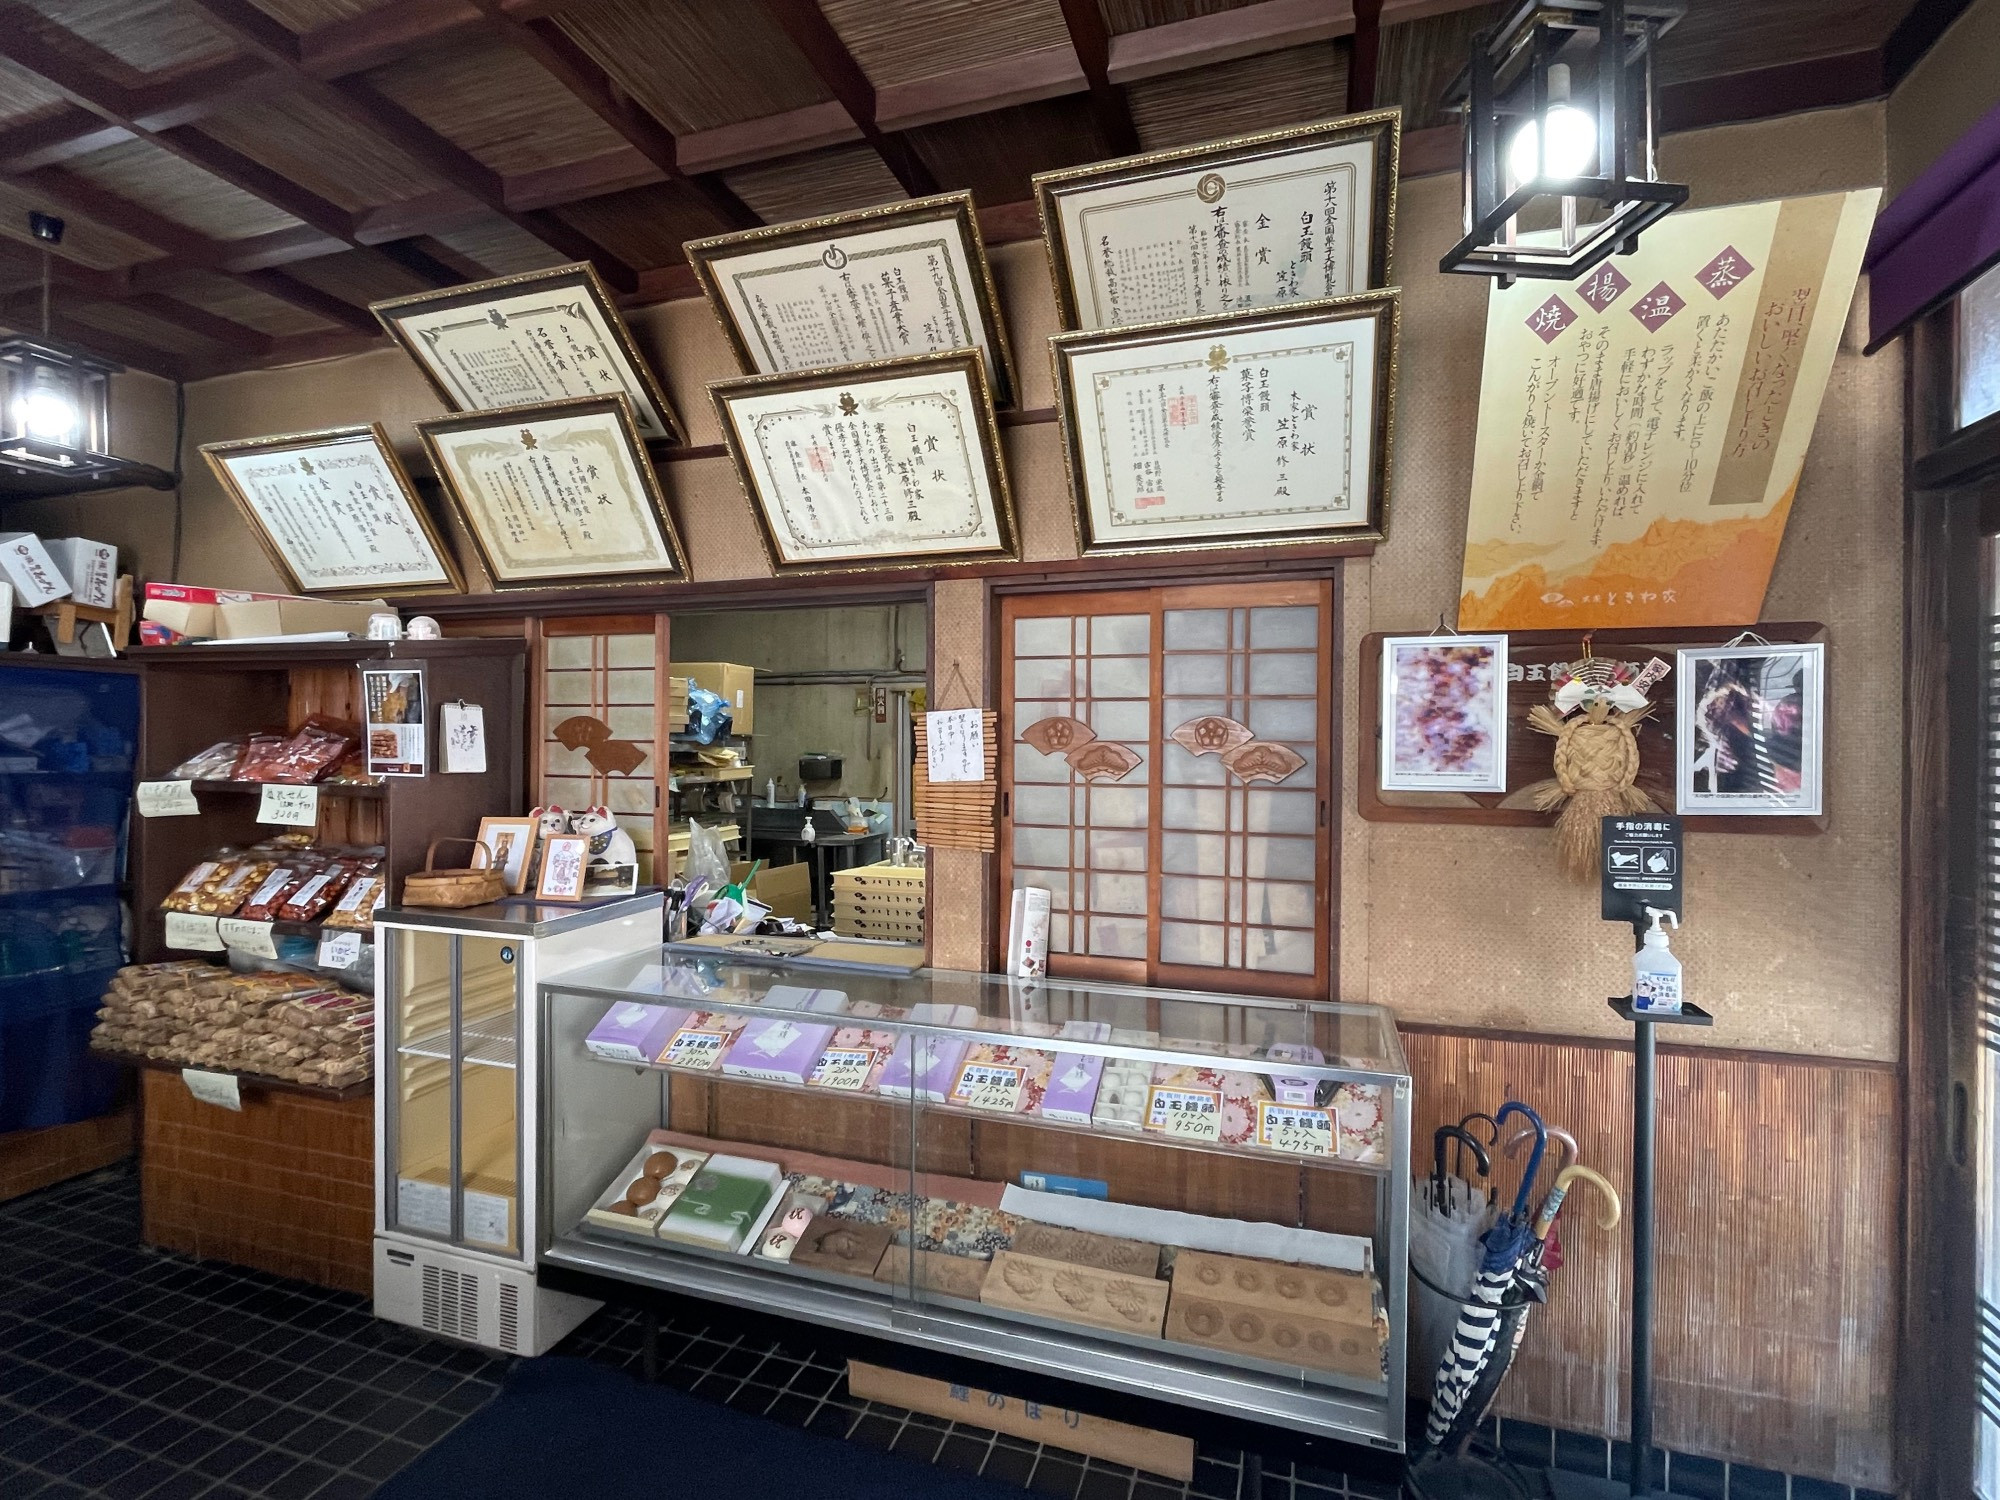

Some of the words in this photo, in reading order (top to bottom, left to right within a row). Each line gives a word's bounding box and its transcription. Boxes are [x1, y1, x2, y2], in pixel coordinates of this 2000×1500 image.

[1255, 213, 1271, 265] 金賞
[1299, 211, 1314, 263] 白玉饅頭
[893, 267, 910, 302] 白玉饅頭
[1586, 272, 1618, 303] 揚
[1710, 256, 1741, 289] 蒸
[1535, 304, 1568, 334] 焼
[1641, 294, 1673, 322] 温
[537, 327, 568, 371] 名誉大賞
[559, 324, 586, 361] 白玉饅頭
[584, 345, 613, 382] 賞状
[1258, 367, 1271, 412] 白玉饅頭
[906, 422, 926, 467] 白玉饅頭
[1300, 403, 1318, 457] 賞状
[1630, 344, 1676, 515] ラップをして、電子レンジに入れて
[571, 456, 592, 494] 白玉饅頭
[924, 434, 948, 482] 賞状
[586, 464, 613, 505] 賞状
[897, 461, 922, 522] 笠原修三殿
[906, 457, 925, 501] ときわ家
[368, 484, 399, 525] 賞状
[968, 719, 980, 749] お願い
[1615, 821, 1671, 831] 手指の消毒に
